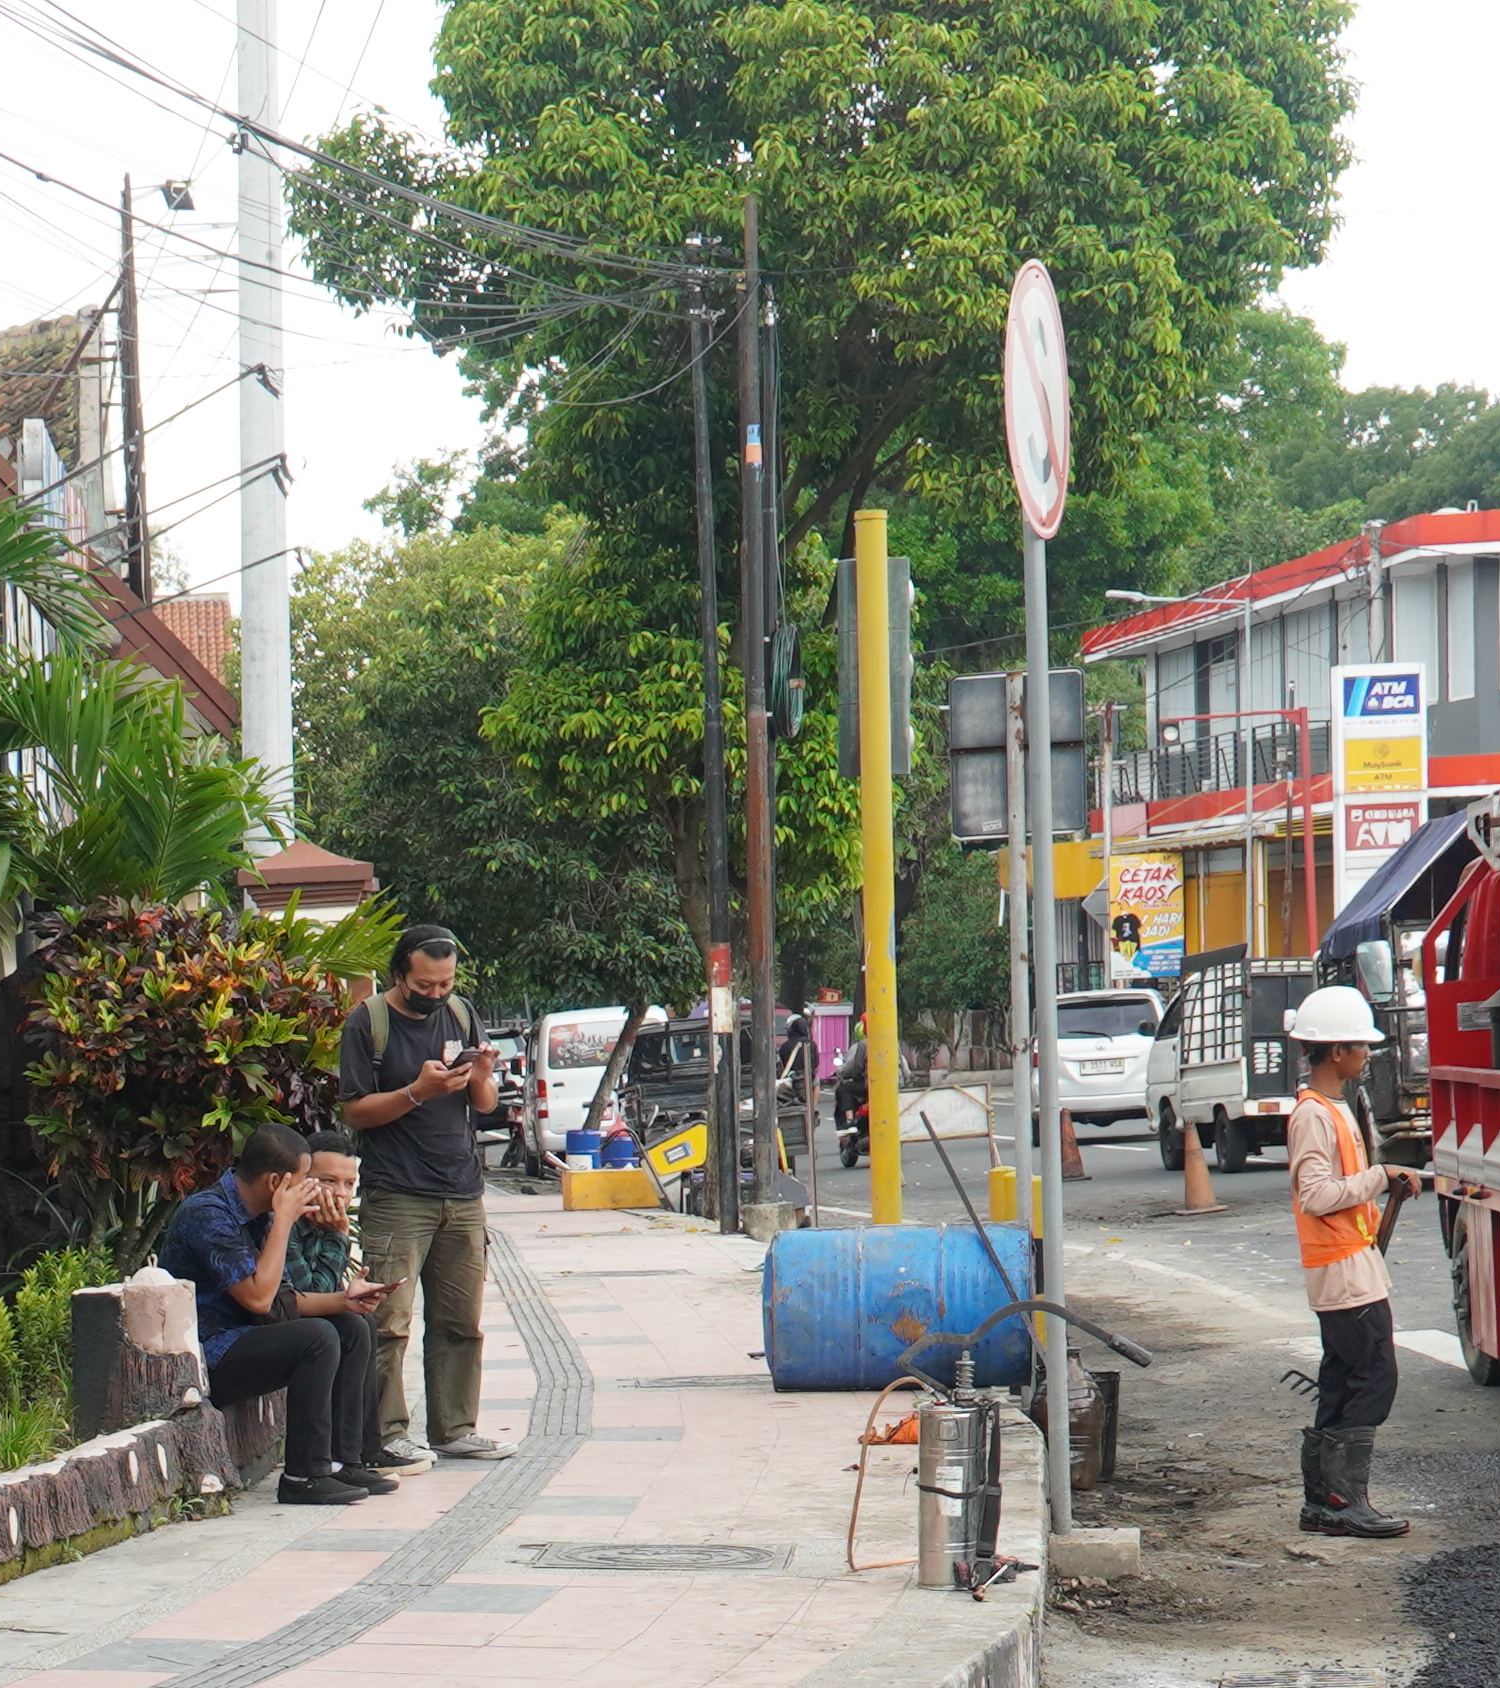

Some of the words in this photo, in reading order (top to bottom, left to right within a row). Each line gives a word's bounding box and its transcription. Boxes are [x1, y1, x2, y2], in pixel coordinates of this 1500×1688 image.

[1370, 681, 1407, 695] ATM
[1381, 695, 1415, 709] BCA
[1363, 760, 1403, 769] Maybank
[1355, 819, 1412, 847] ATM
[1119, 867, 1177, 884] CETAK
[1120, 885, 1167, 900] KAOS
[1153, 912, 1183, 925] HARI
